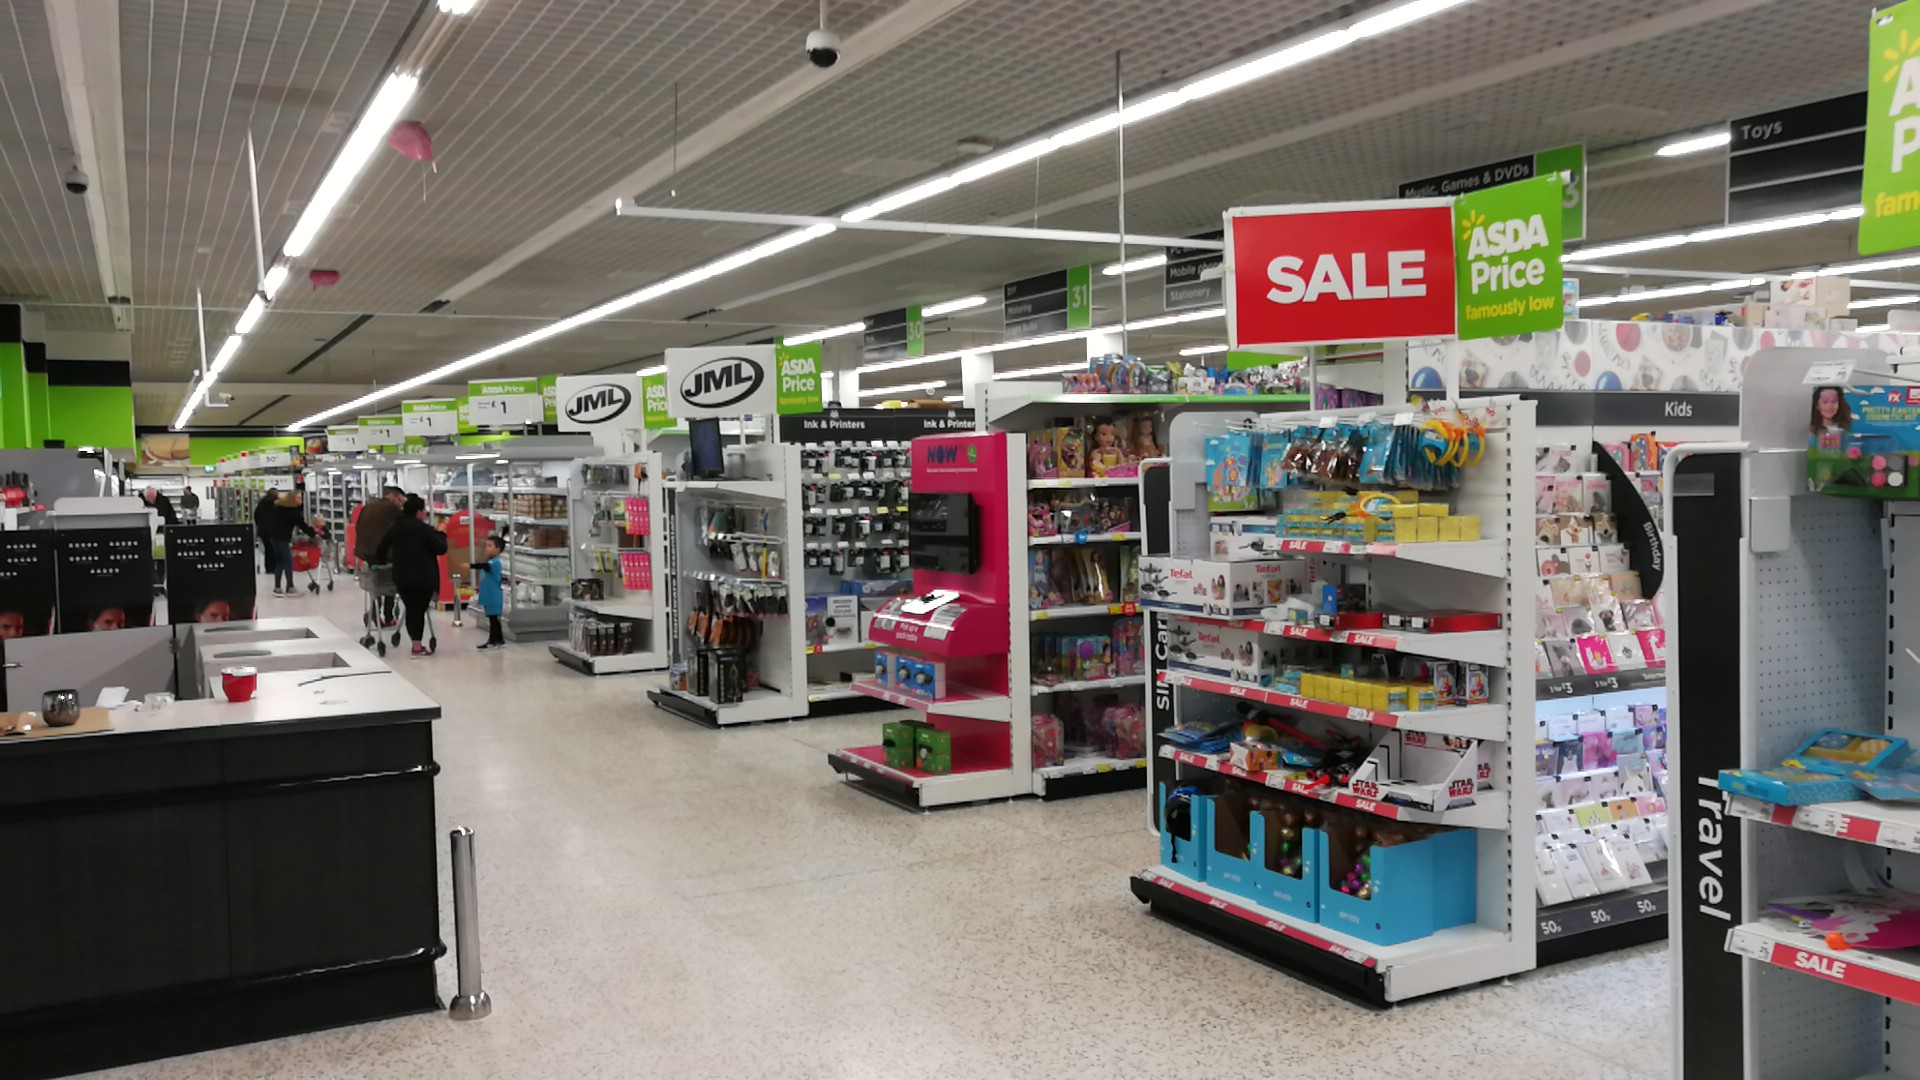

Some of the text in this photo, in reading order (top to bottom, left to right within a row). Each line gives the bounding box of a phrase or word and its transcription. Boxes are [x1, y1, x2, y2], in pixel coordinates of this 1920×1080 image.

[1741, 120, 1783, 140] Toys
[1441, 171, 1480, 194] Games
[1484, 169, 1492, 185] &
[1494, 162, 1531, 182] DVDs
[1466, 213, 1550, 261] ASDA
[1265, 249, 1428, 305] SALE
[1471, 256, 1546, 295] Price
[1071, 283, 1089, 309] 31
[1464, 295, 1556, 321] famously low
[907, 320, 922, 341] 30
[781, 357, 817, 377] ASDA
[683, 361, 753, 398] JML
[782, 374, 816, 394] Price
[567, 388, 623, 417] JML
[1664, 400, 1693, 418] Kids
[803, 418, 866, 430] Ink & Printers
[923, 418, 976, 430] Ink & Printer
[1288, 540, 1307, 550] SALE
[1642, 521, 1662, 572] Birthday
[1169, 568, 1193, 580] Tefal
[1255, 564, 1281, 574] Tefal
[1197, 631, 1221, 644] Tefal
[1289, 626, 1375, 645] SALE SALE
[1228, 686, 1247, 697] SALE
[1289, 697, 1309, 709] SALE
[1178, 752, 1195, 763] SALE
[1355, 799, 1376, 812] SALE
[1353, 779, 1379, 790] STAR
[1448, 785, 1475, 798] WARS
[1450, 777, 1474, 789] STAR
[1352, 786, 1380, 799] WARS
[1209, 898, 1228, 910] SALE
[1265, 920, 1287, 933] SALE
[1794, 950, 1848, 980] SALE
